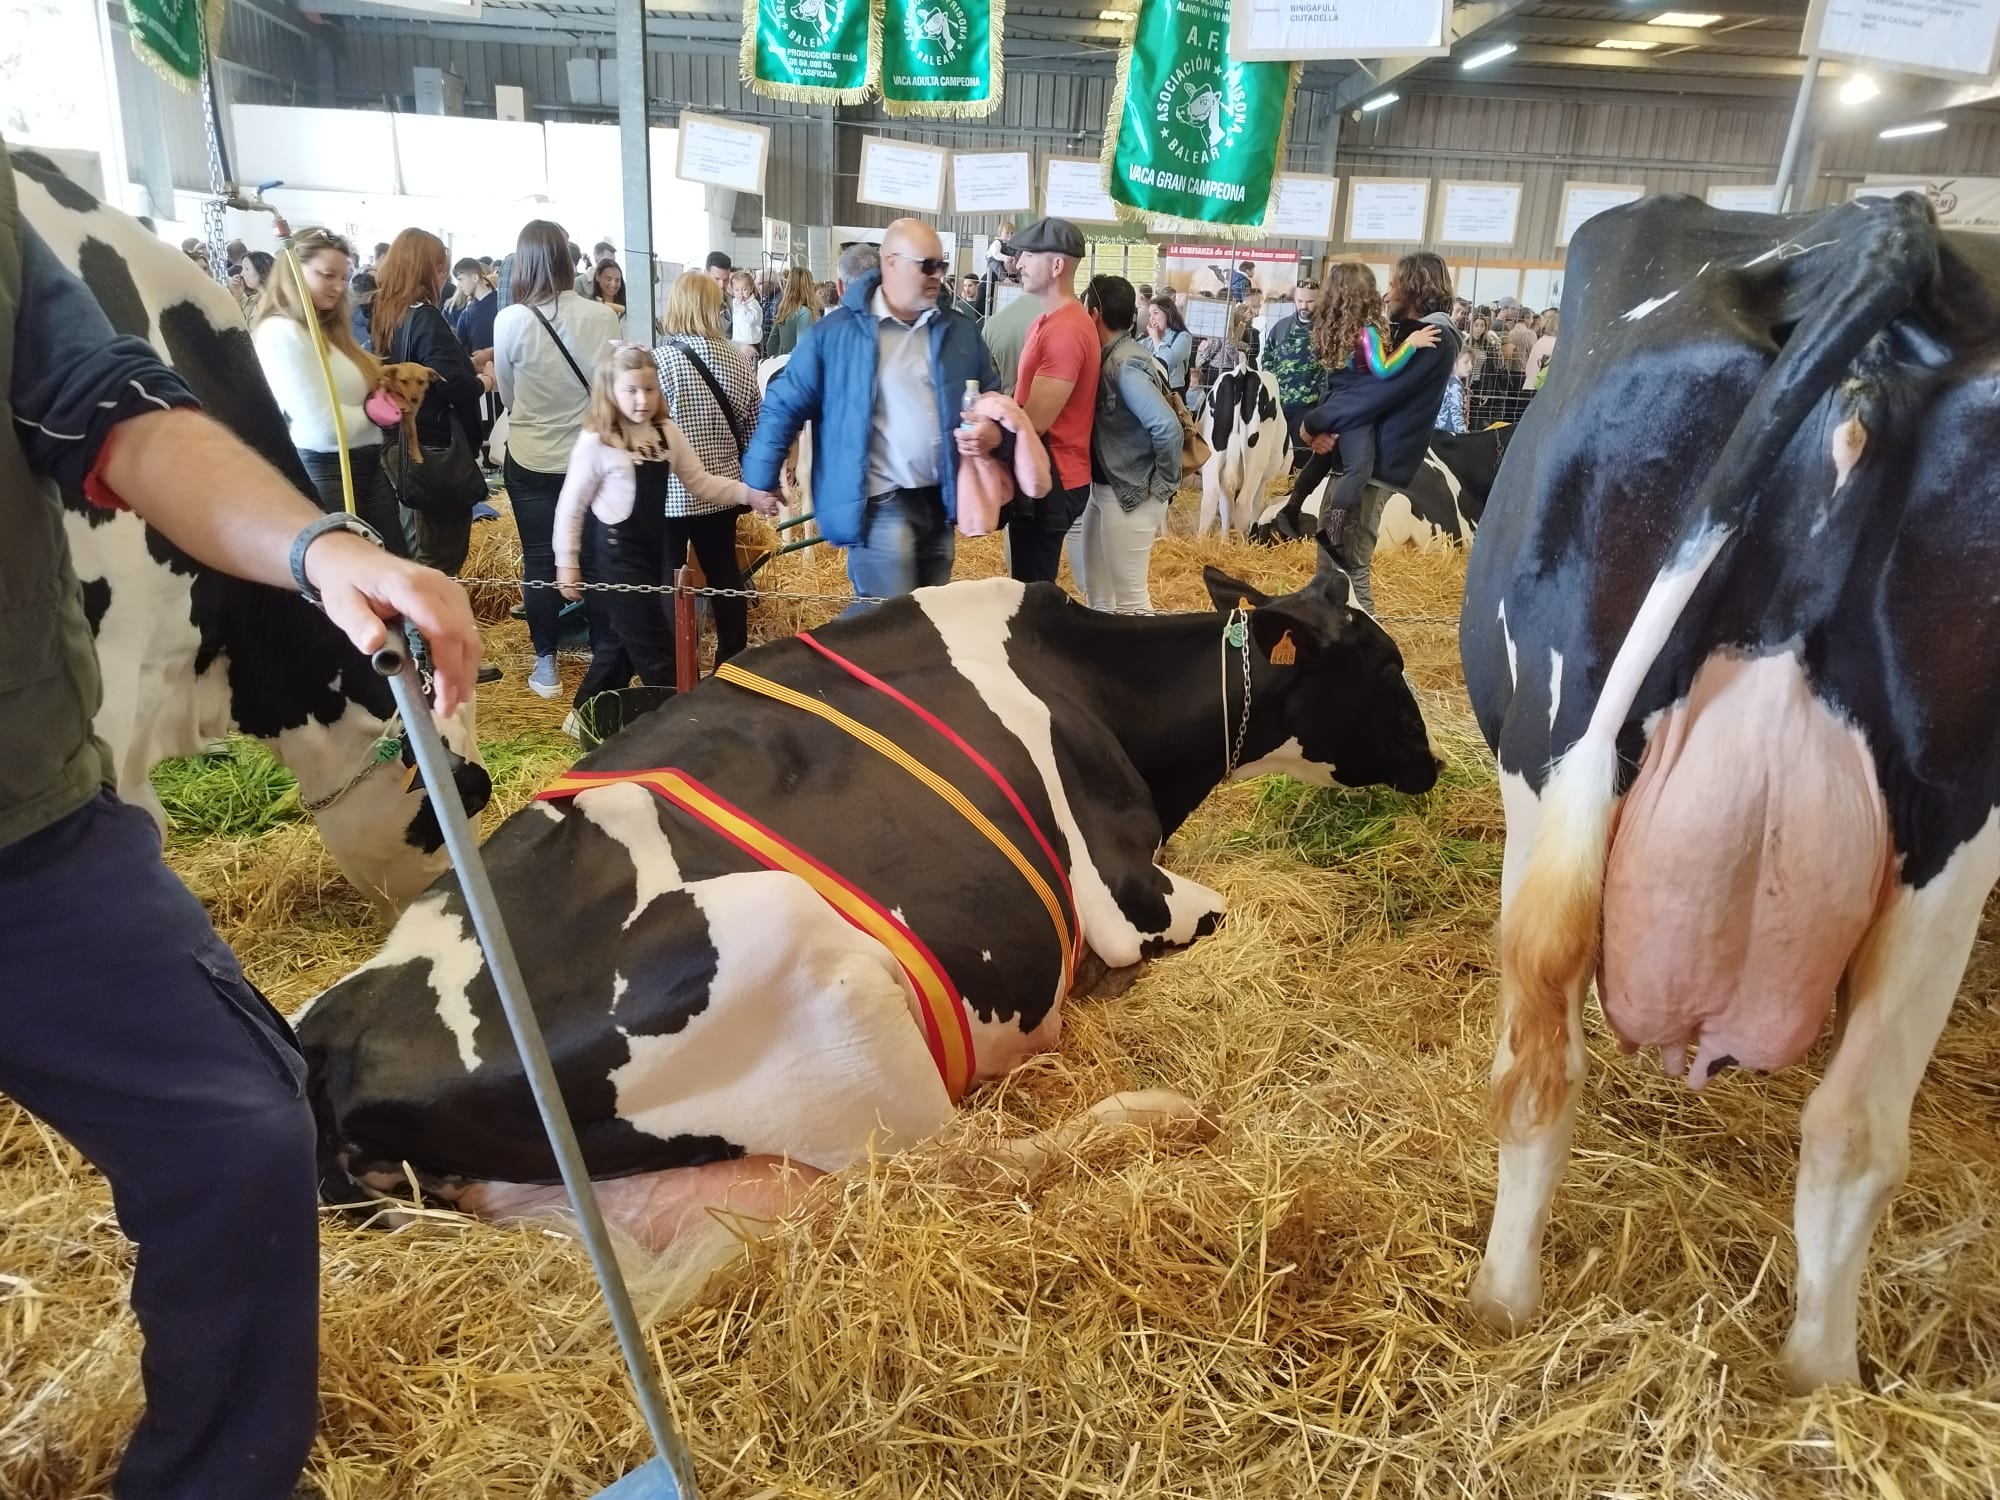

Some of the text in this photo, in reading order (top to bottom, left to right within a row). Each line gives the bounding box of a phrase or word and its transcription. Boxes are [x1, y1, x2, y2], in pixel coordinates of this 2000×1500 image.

[1290, 4, 1337, 12] BINIGAFULL
[1290, 14, 1339, 22] CIUTADELLA
[788, 29, 831, 49] BALEAR
[787, 48, 831, 60] PRODUCCIÓN
[842, 52, 858, 62] MÁS
[916, 50, 956, 66] BALEAR
[893, 75, 981, 88] VACA ADULTA CAMPEONA
[1156, 54, 1212, 122] ASOCIACIÓN
[1168, 138, 1221, 164] BALEAR
[1129, 163, 1155, 186] VACA
[1156, 171, 1188, 192] GRAN
[1188, 177, 1247, 203] CAMPEONA
[1170, 246, 1179, 254] LA
[1179, 246, 1215, 256] CONFIANZA
[1215, 248, 1223, 256] de
[380, 741, 399, 759] 139
